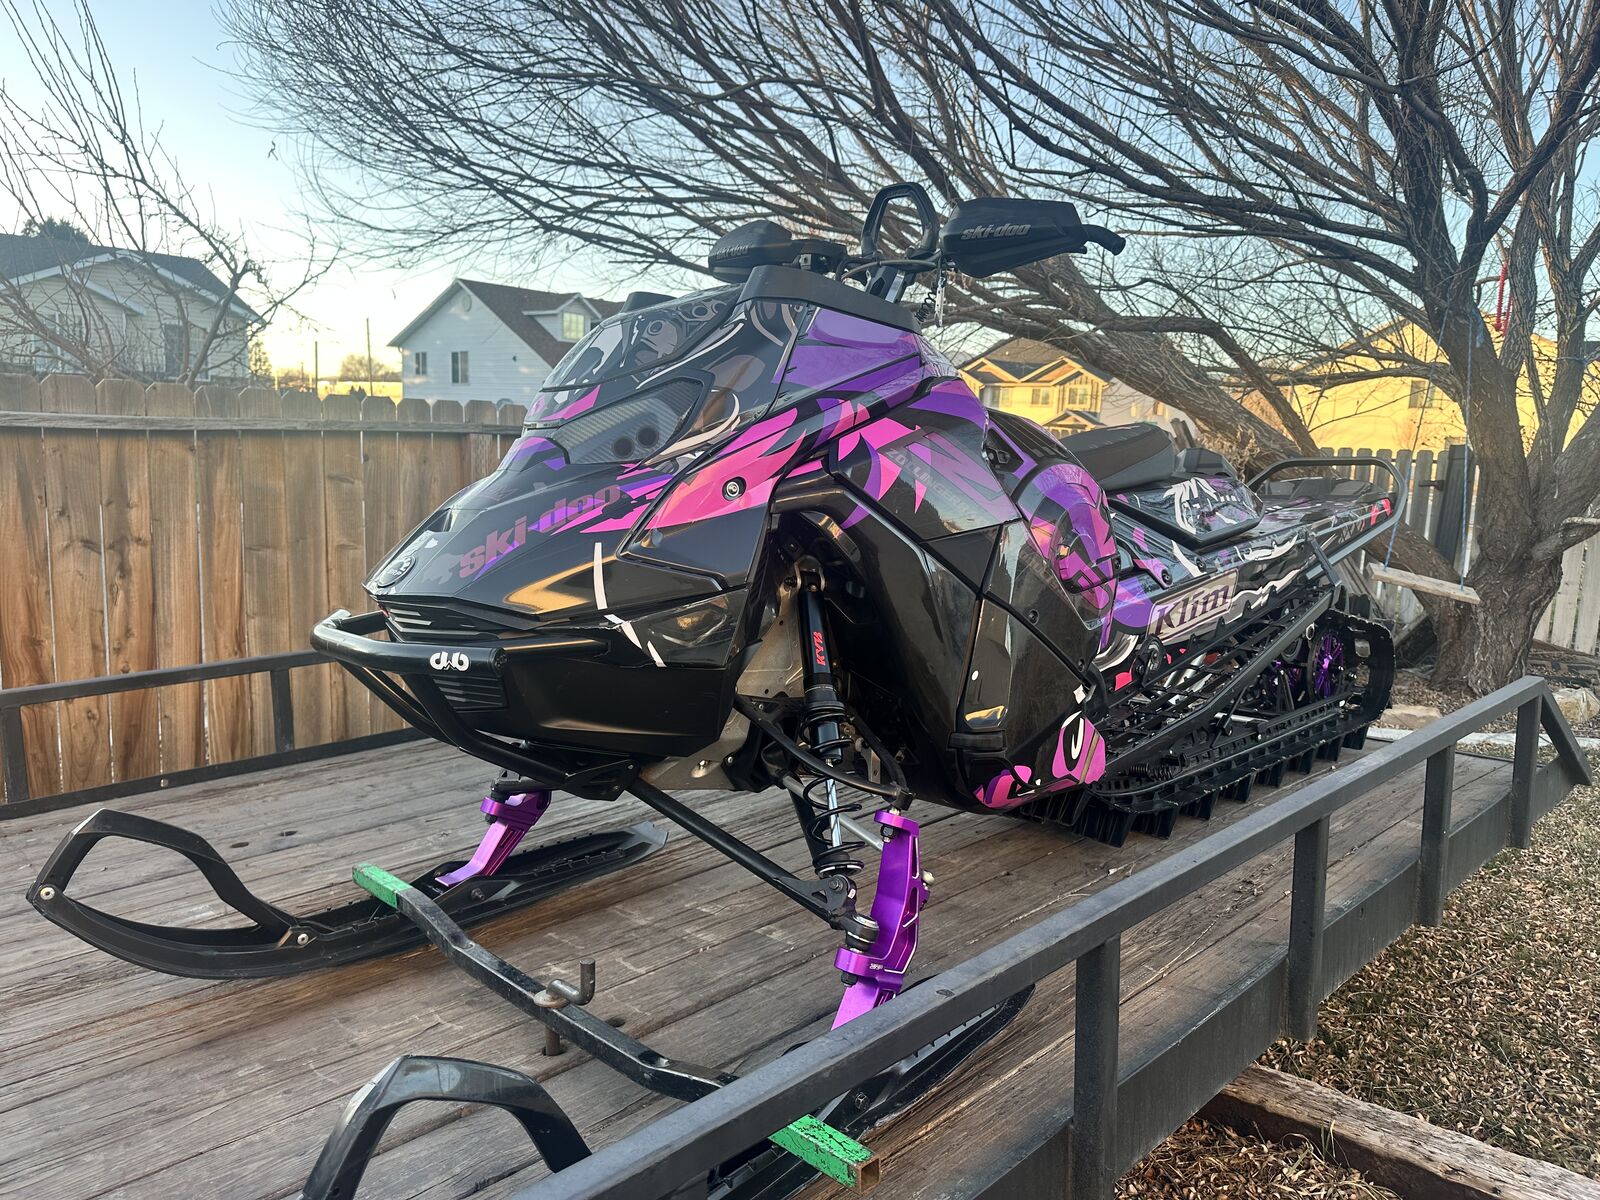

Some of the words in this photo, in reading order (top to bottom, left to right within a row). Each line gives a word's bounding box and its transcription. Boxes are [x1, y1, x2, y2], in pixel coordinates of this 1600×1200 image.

[961, 223, 1032, 240] ski-doo
[459, 484, 620, 577] ski-doo
[1154, 585, 1229, 635] Klim
[813, 632, 827, 666] KYB
